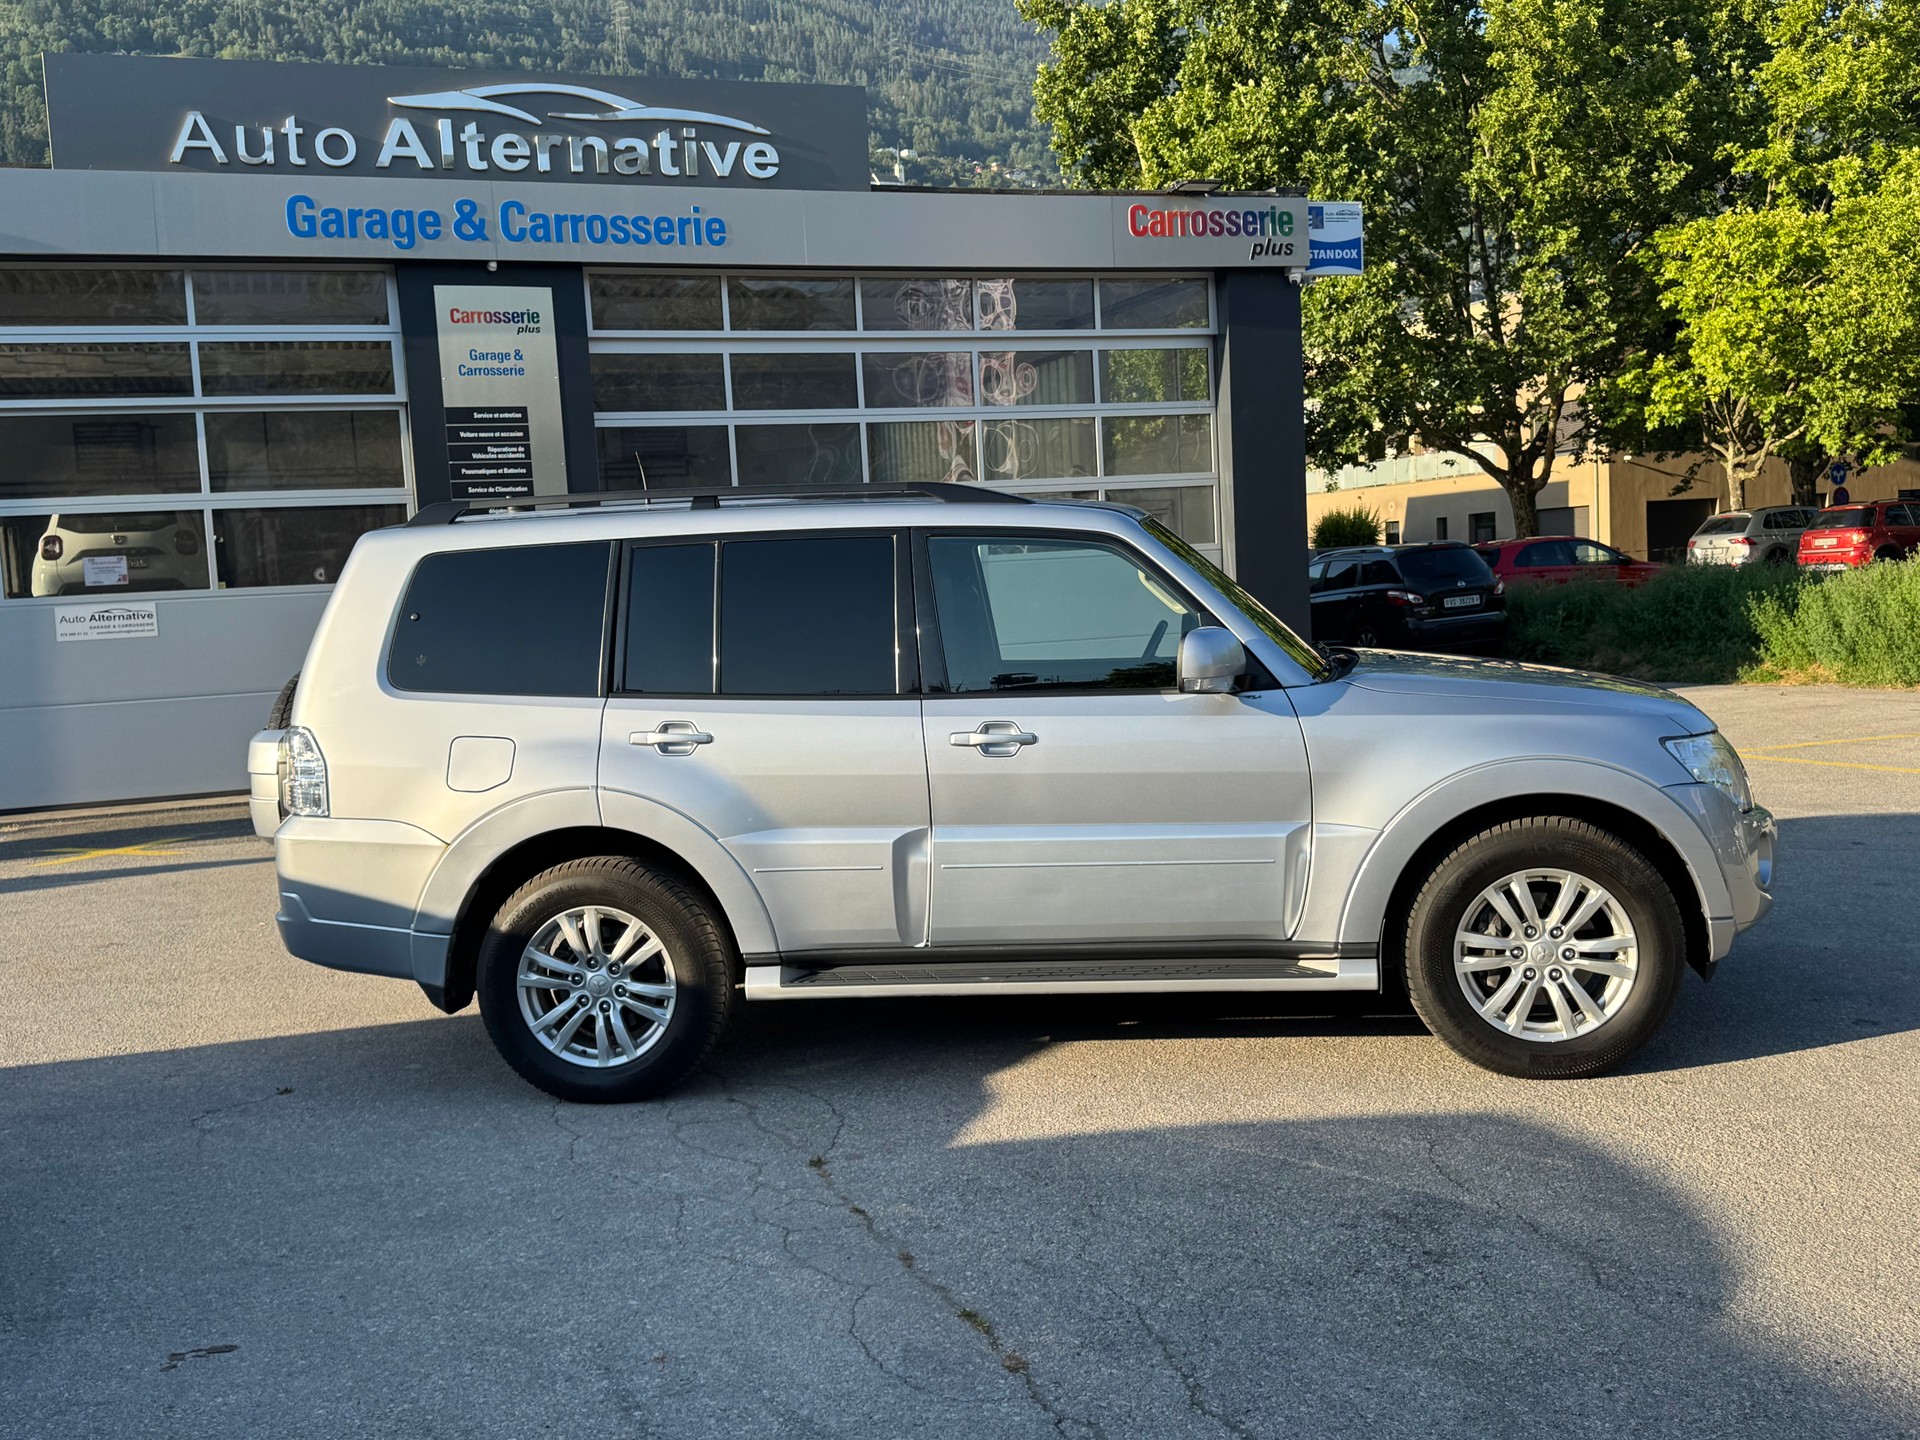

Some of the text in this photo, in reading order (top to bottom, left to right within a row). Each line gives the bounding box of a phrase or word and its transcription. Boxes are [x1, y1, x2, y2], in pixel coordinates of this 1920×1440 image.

[169, 110, 780, 180] Auto Alternative
[285, 194, 728, 249] Garage & Carrosserie
[1128, 203, 1295, 237] Carrosserie
[1249, 238, 1295, 261] plus
[450, 308, 540, 324] Carrosserie
[517, 324, 541, 335] plus
[469, 348, 525, 364] Garage &
[458, 363, 525, 377] Carrosserie
[495, 485, 528, 493] Climatisation
[59, 612, 154, 624] Auto Alternative
